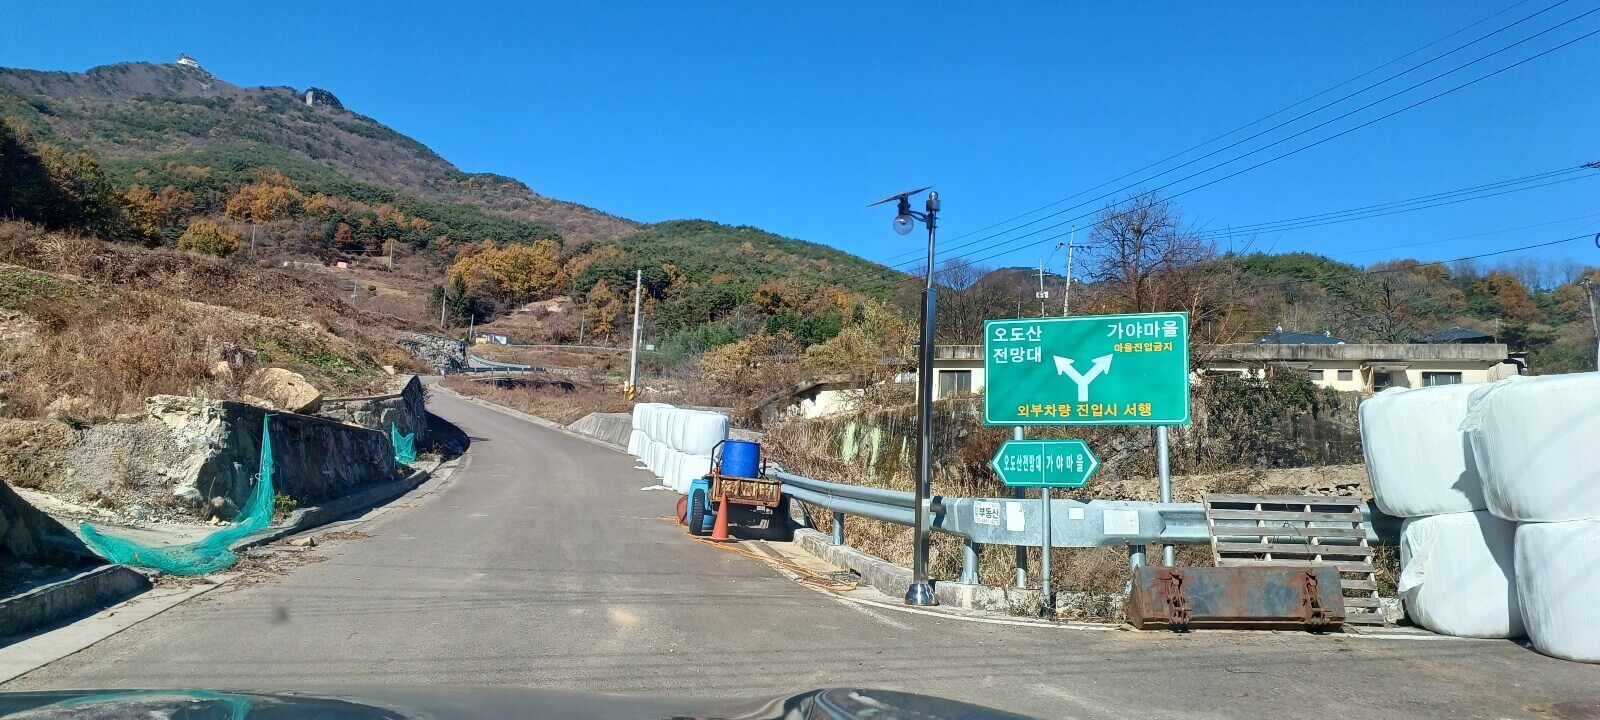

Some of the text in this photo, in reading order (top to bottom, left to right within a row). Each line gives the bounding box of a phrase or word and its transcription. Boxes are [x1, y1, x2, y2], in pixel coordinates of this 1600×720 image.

[993, 325, 1042, 342] 오도산
[1107, 320, 1179, 339] 가야마을
[993, 346, 1042, 364] 전망대
[1114, 342, 1173, 353] 마을진입금지
[1016, 403, 1152, 417] 외부차량 진입시 서행
[1003, 454, 1042, 472] 오도산전망대
[979, 507, 999, 519] 부동산
